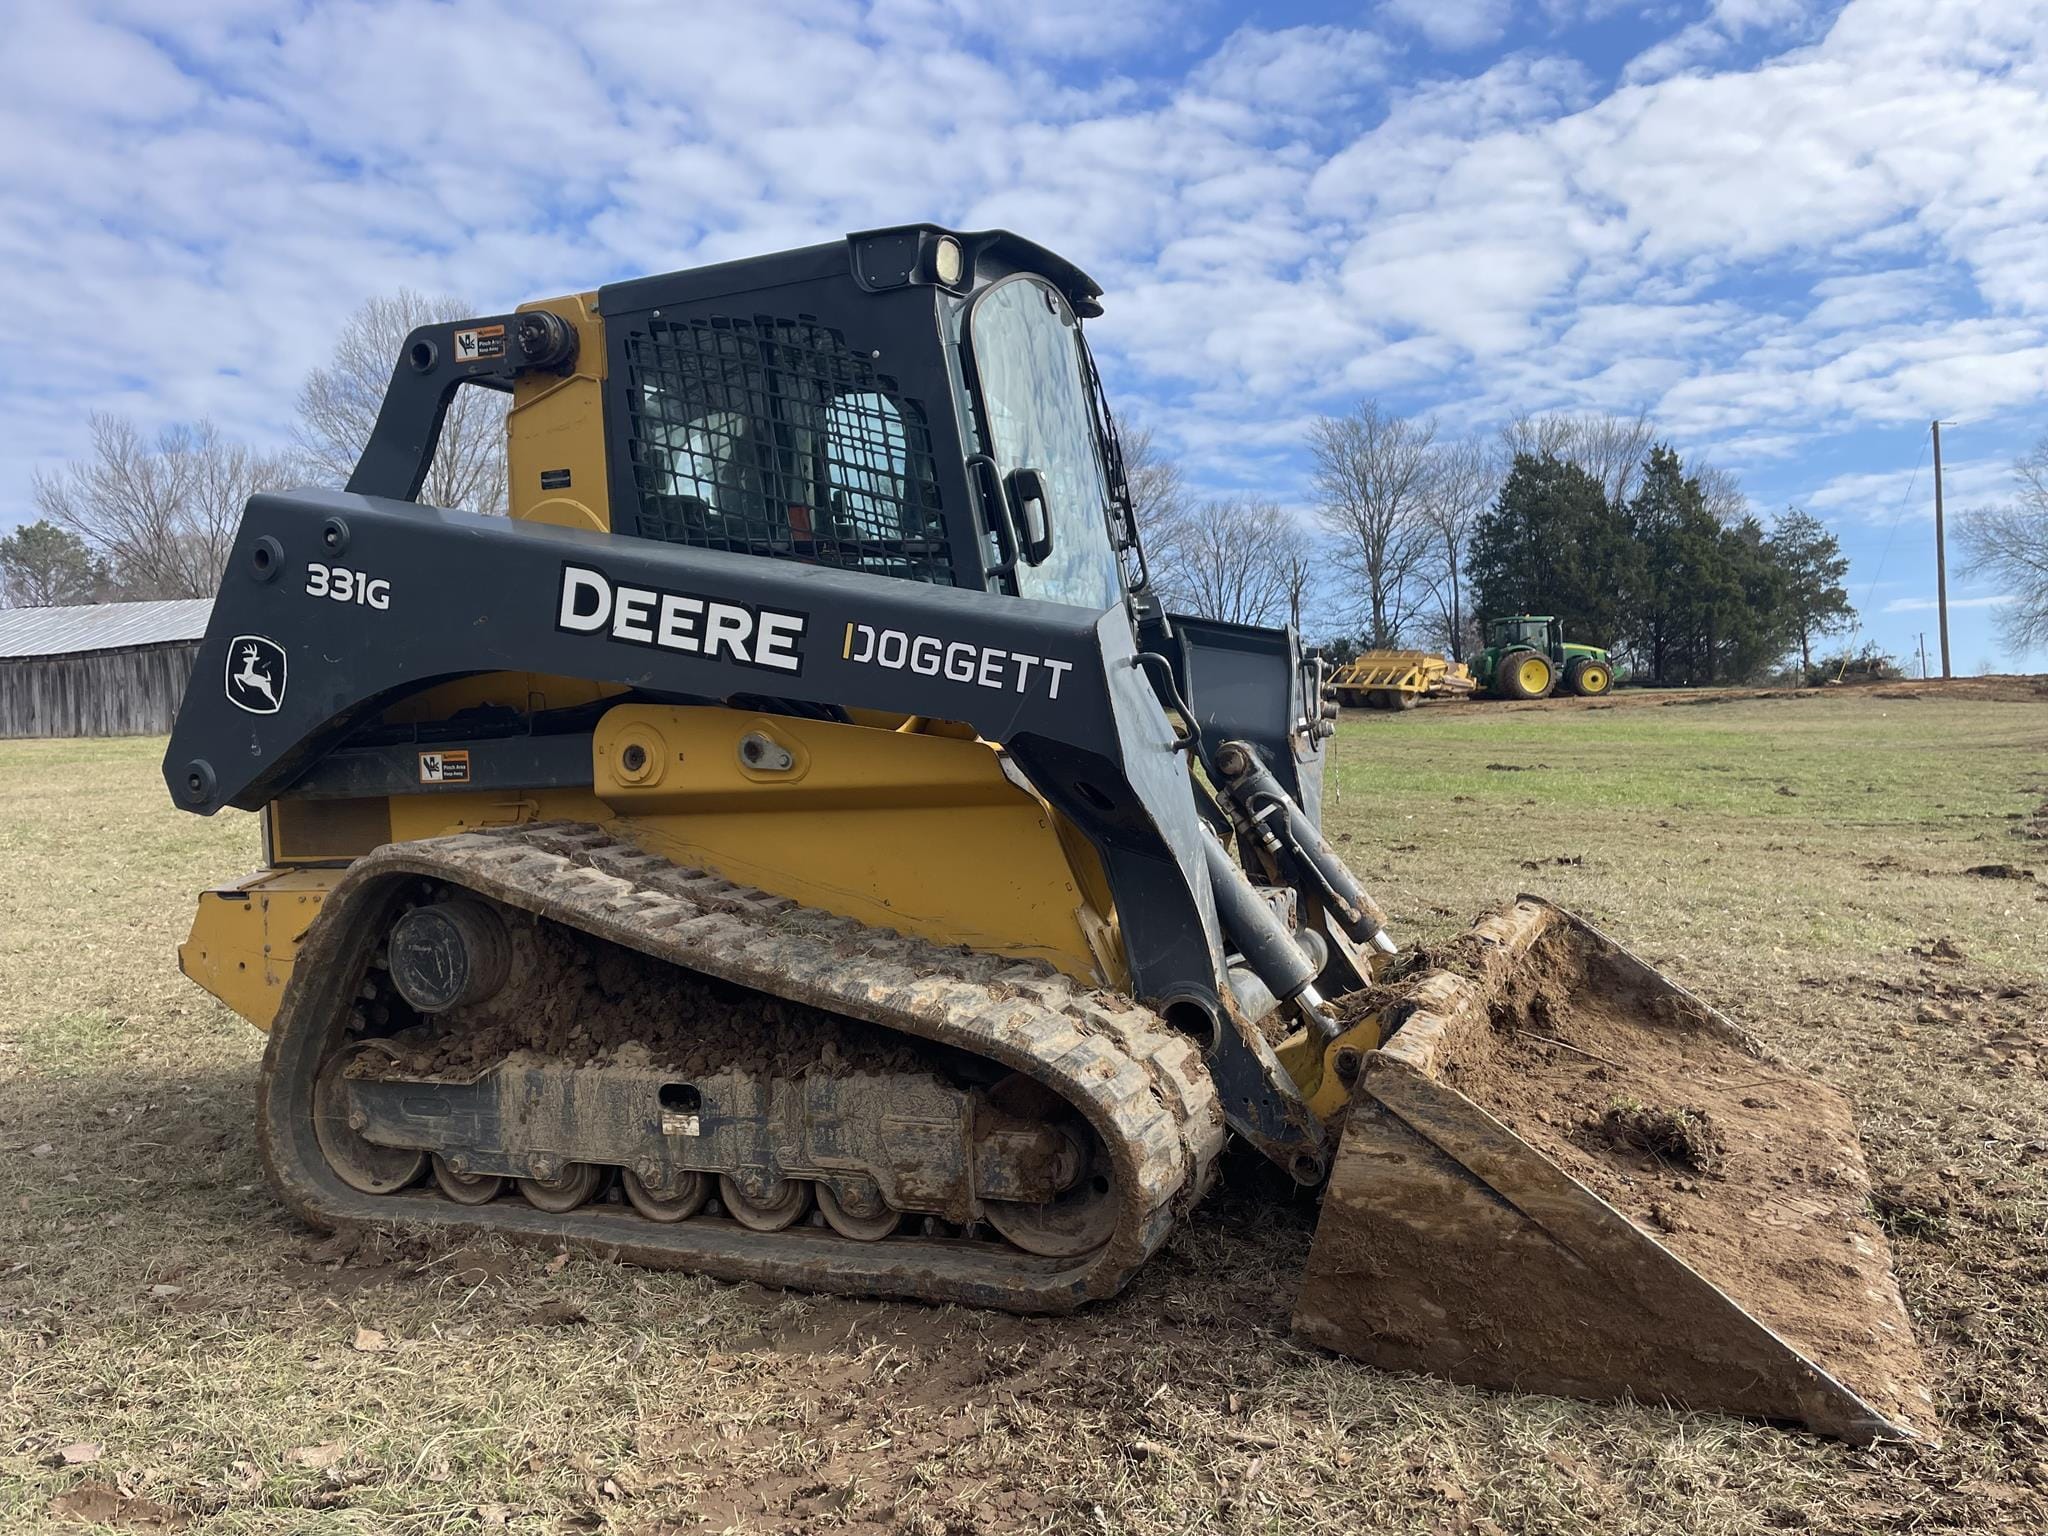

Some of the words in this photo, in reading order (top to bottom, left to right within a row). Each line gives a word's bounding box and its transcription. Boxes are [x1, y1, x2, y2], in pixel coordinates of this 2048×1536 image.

[306, 563, 390, 610] 331G
[559, 566, 803, 670] DEERE
[843, 621, 1073, 699] DOGGETT
